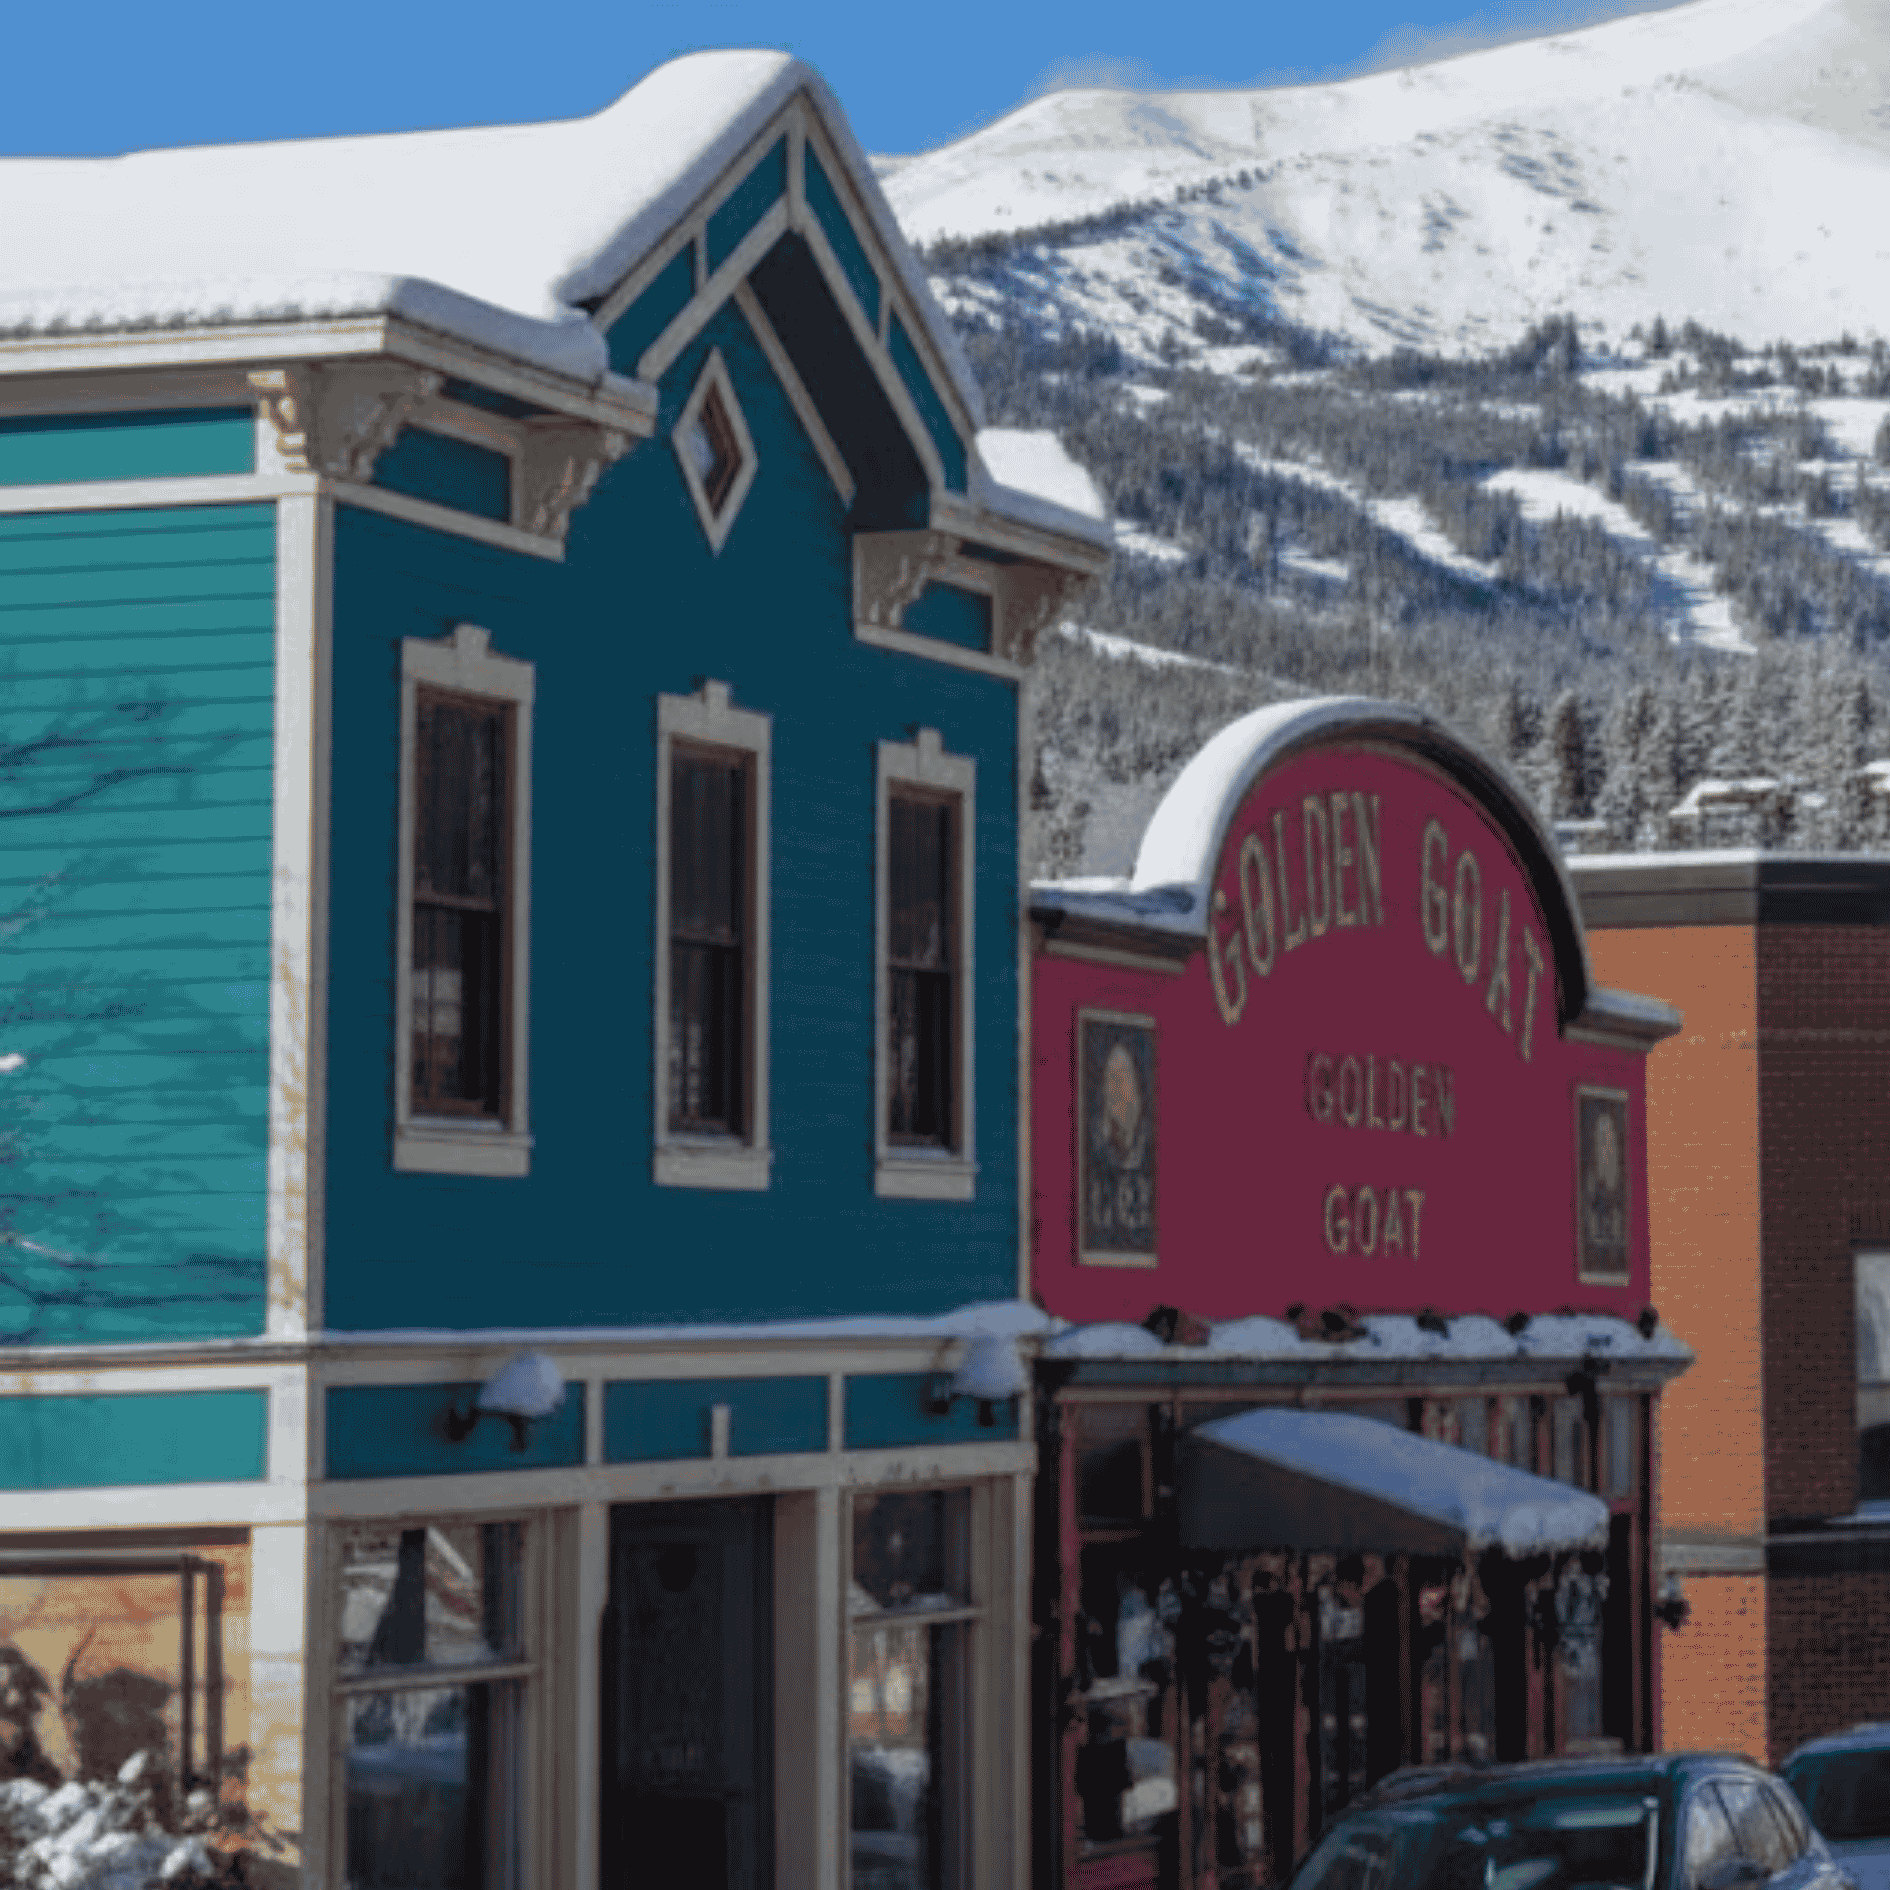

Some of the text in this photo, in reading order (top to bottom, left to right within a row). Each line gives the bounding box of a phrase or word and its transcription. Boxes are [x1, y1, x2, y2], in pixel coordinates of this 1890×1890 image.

[1208, 791, 1545, 1061] GOLDEN GOAT
[1309, 1053, 1456, 1138] GOLDEN
[1322, 1184, 1426, 1261] GOAT
